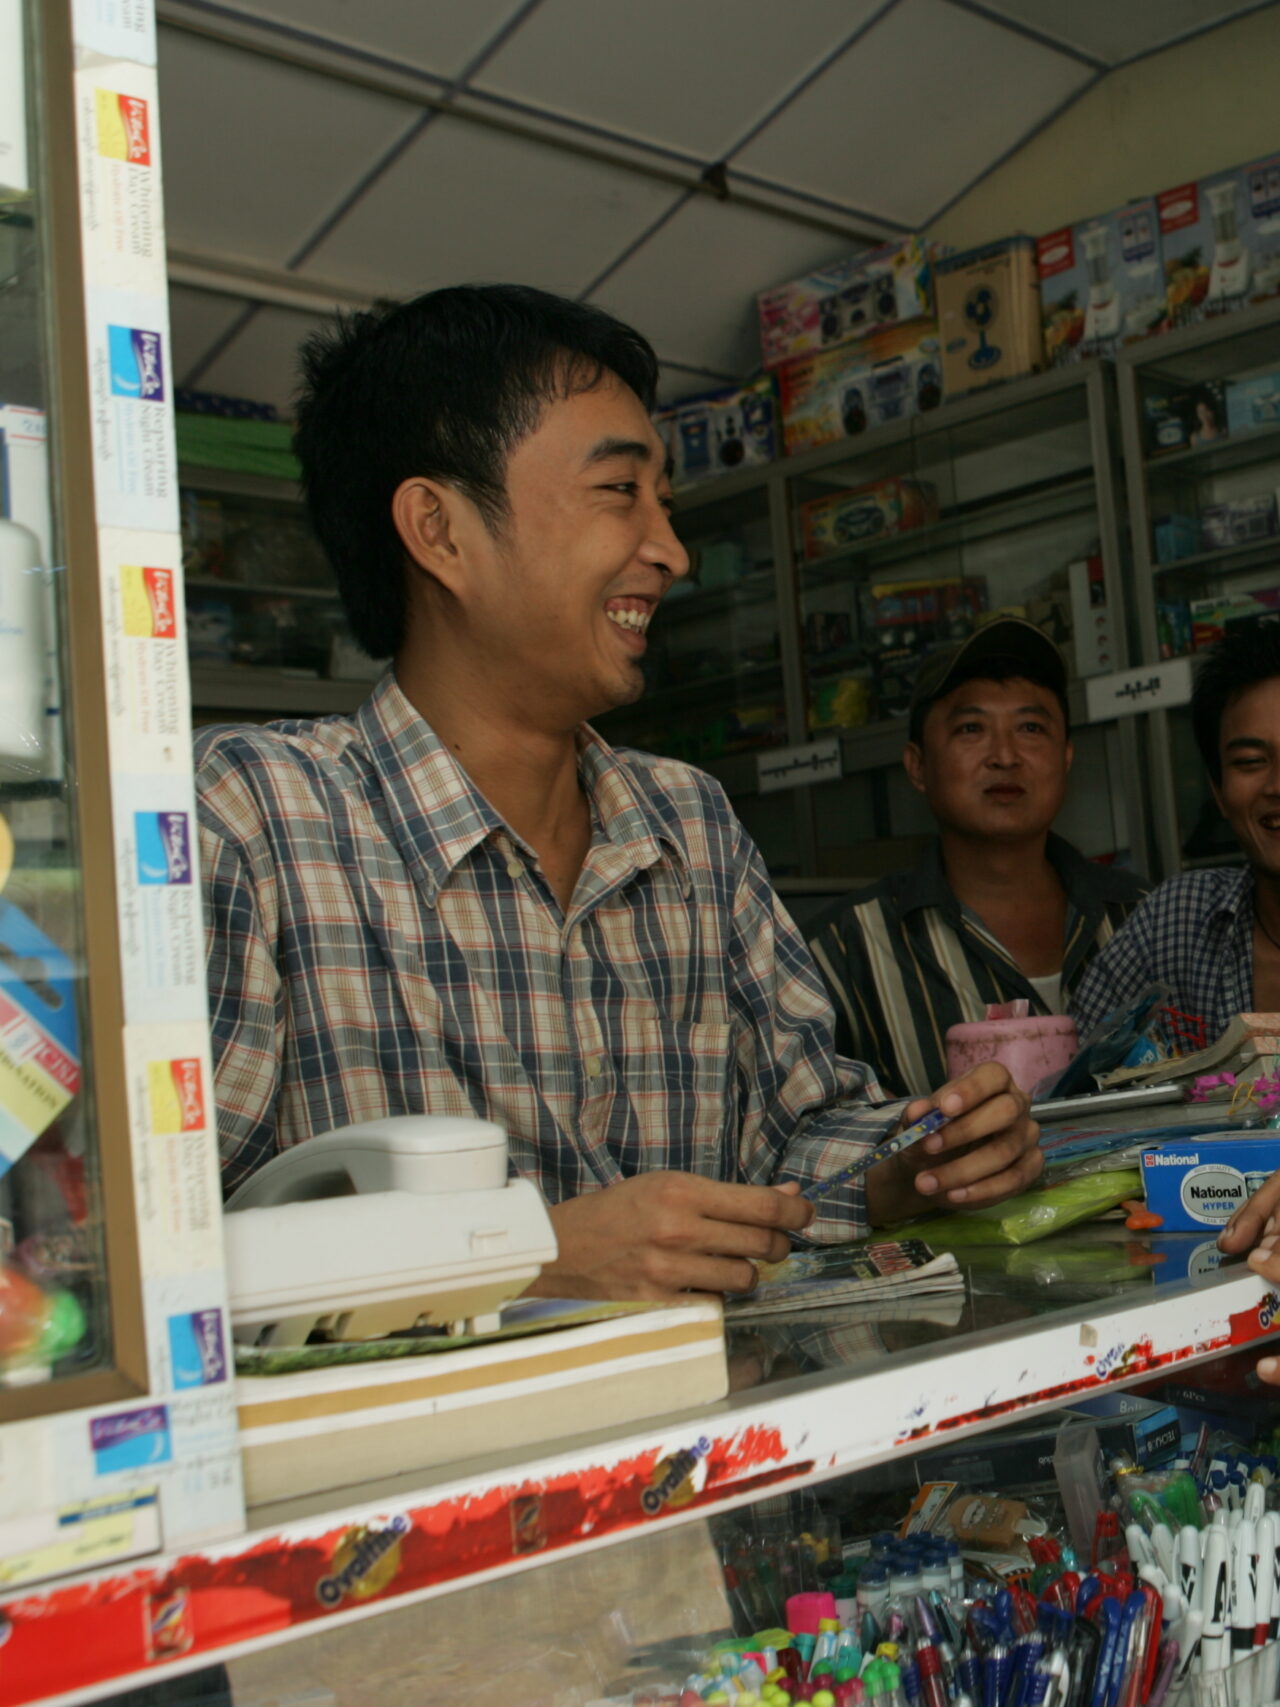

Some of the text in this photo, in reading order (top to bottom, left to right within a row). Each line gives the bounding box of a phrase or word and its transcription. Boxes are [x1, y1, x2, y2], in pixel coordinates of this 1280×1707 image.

[1155, 1153, 1199, 1167] National
[1190, 1184, 1242, 1199] National
[1202, 1201, 1235, 1210] HYPER
[315, 1514, 412, 1608] Ovaltine
